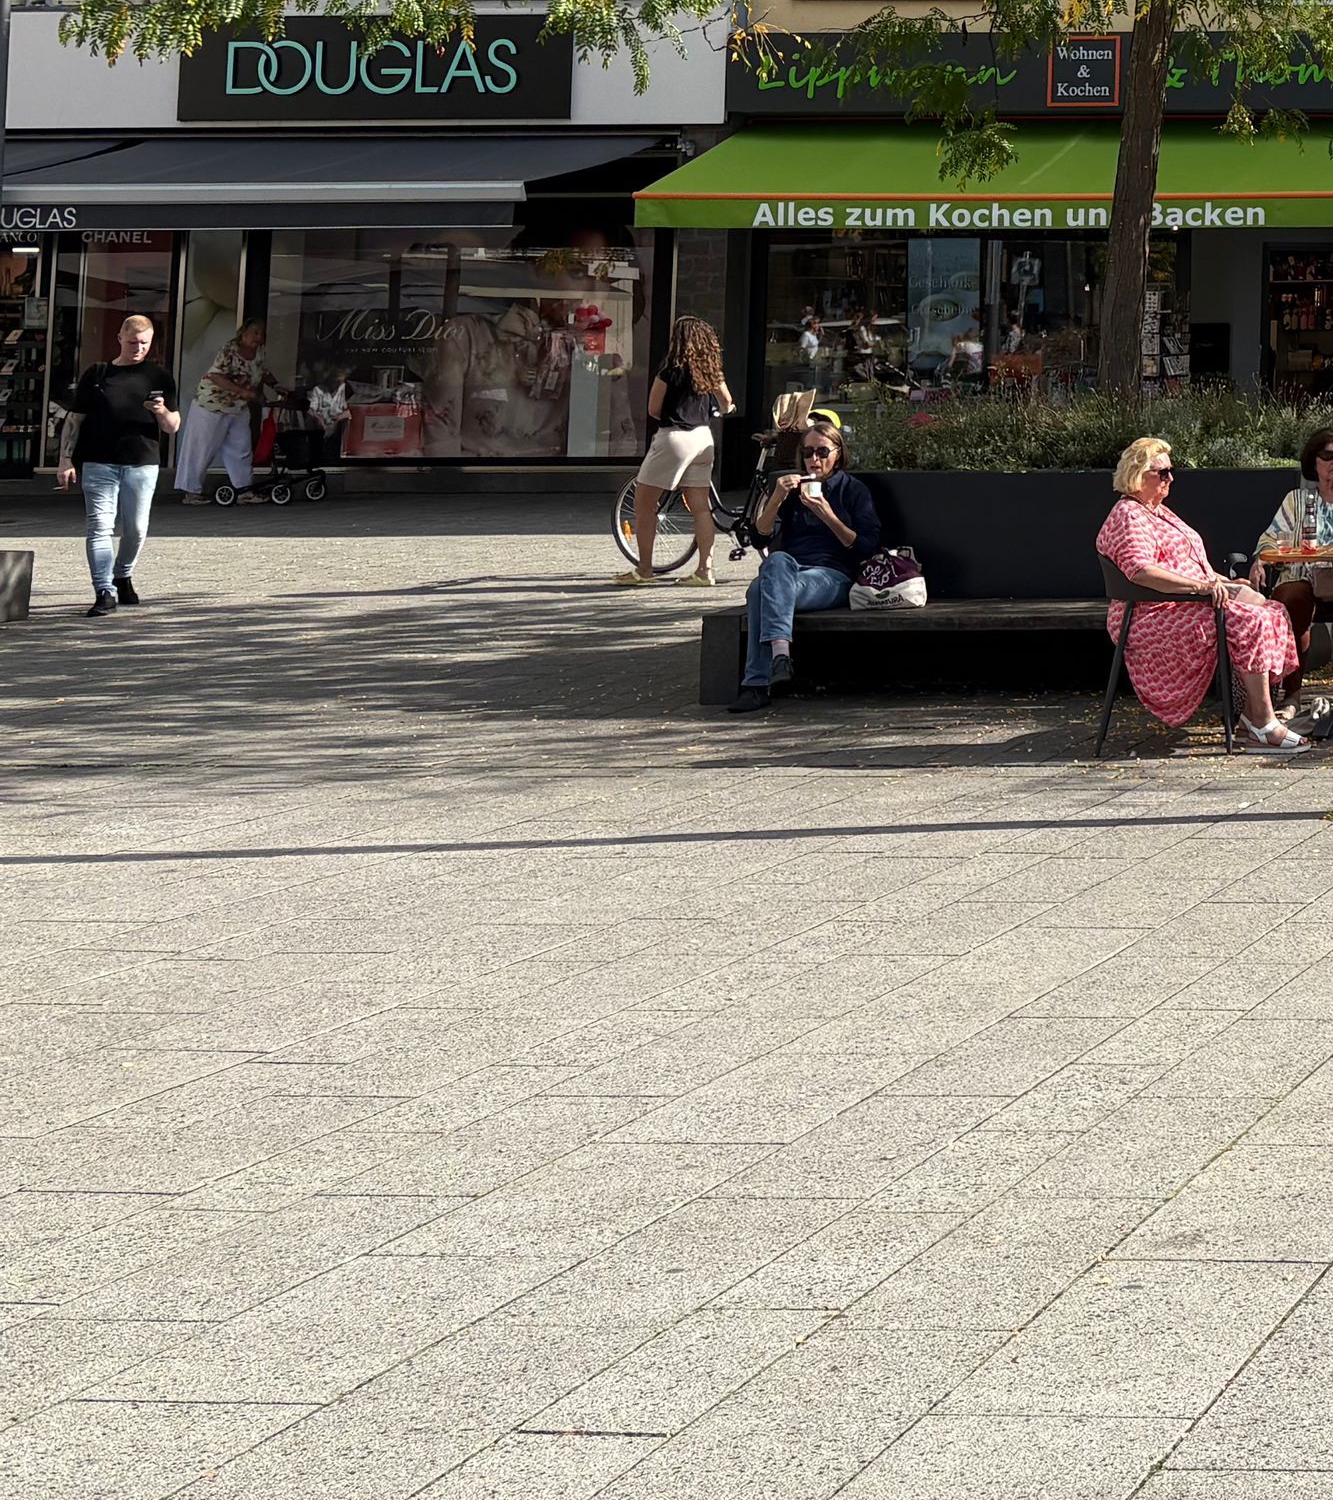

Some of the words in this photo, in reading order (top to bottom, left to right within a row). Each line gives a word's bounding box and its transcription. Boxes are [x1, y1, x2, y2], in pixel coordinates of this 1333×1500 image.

[1056, 46, 1113, 60] Wohnen
[225, 39, 518, 95] DOUGLAS
[1077, 64, 1091, 79] &
[1056, 82, 1111, 97] Kochen
[752, 202, 834, 227] Alles
[845, 207, 916, 227] zum
[928, 202, 1053, 227] Kochen
[1065, 206, 1110, 227] un
[81, 231, 153, 244] CHANEL
[316, 308, 396, 341] Miss
